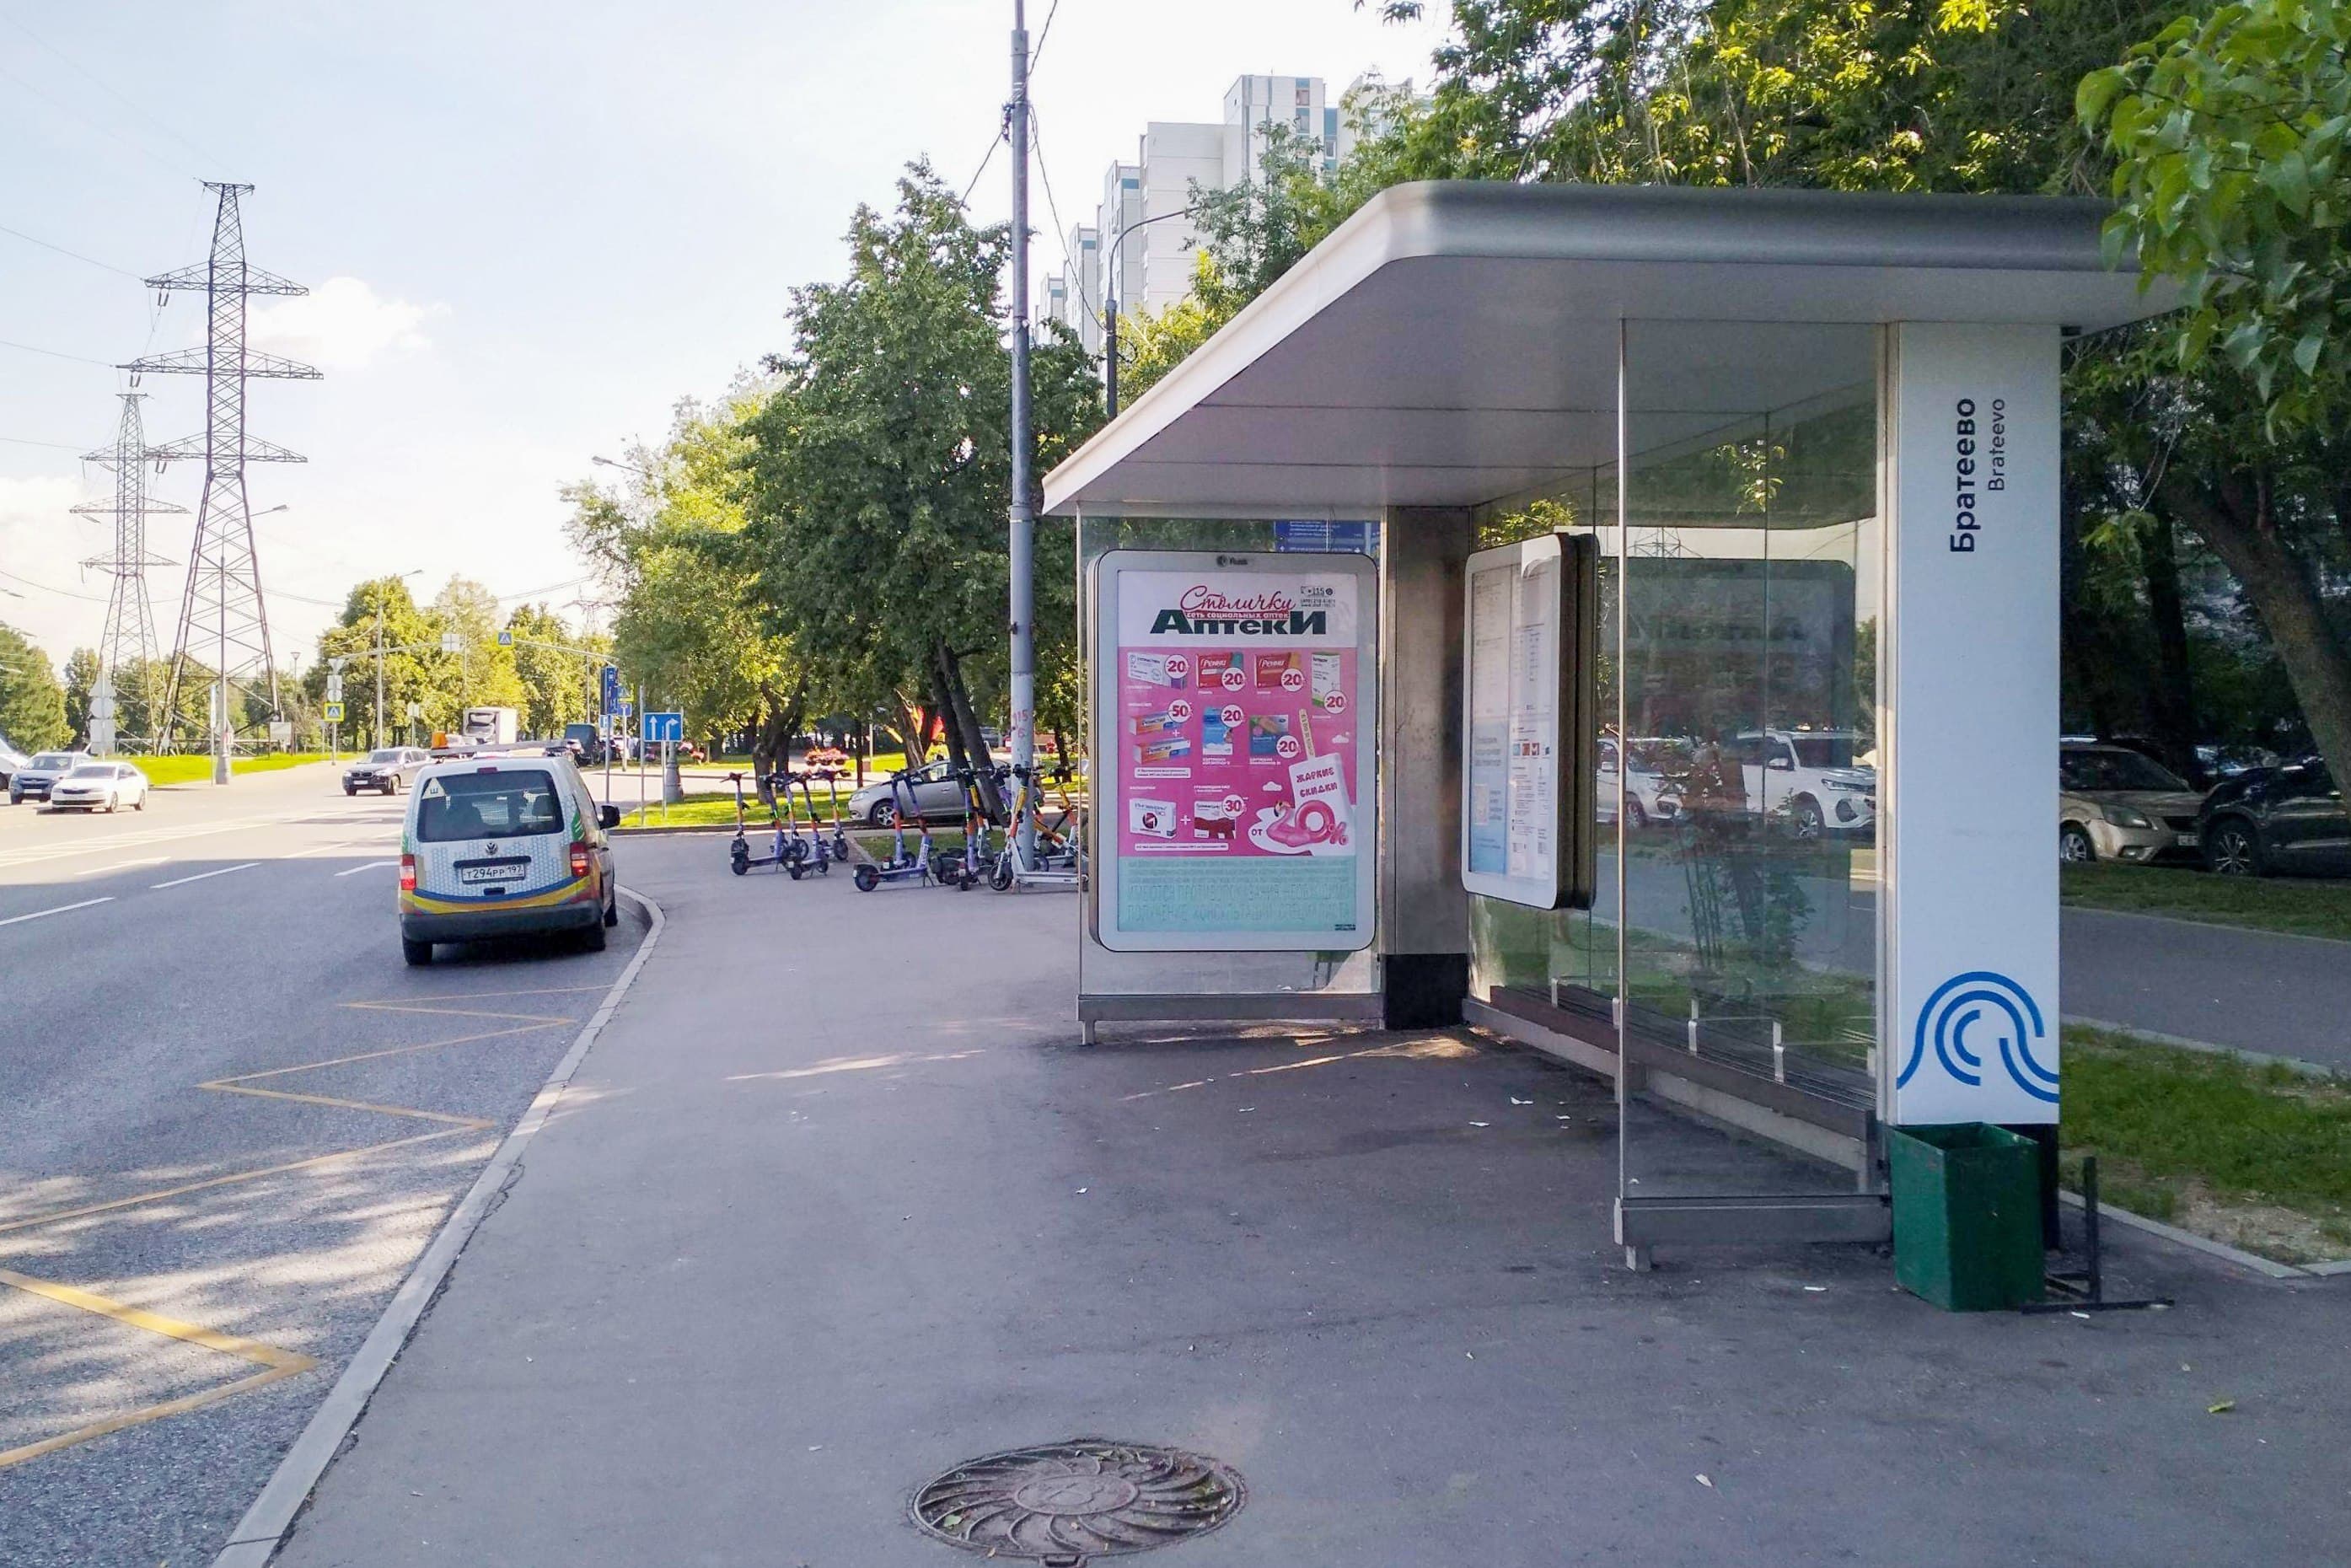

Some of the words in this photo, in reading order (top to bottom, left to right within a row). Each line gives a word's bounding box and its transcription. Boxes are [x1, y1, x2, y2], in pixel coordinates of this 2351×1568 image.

[1988, 398, 2005, 491] Brateevo
[1950, 398, 1981, 552] Братеево
[1180, 585, 1296, 610] Столички
[1296, 767, 1334, 783] ЖАРКИЕ
[1300, 781, 1338, 797] СКИДКИ
